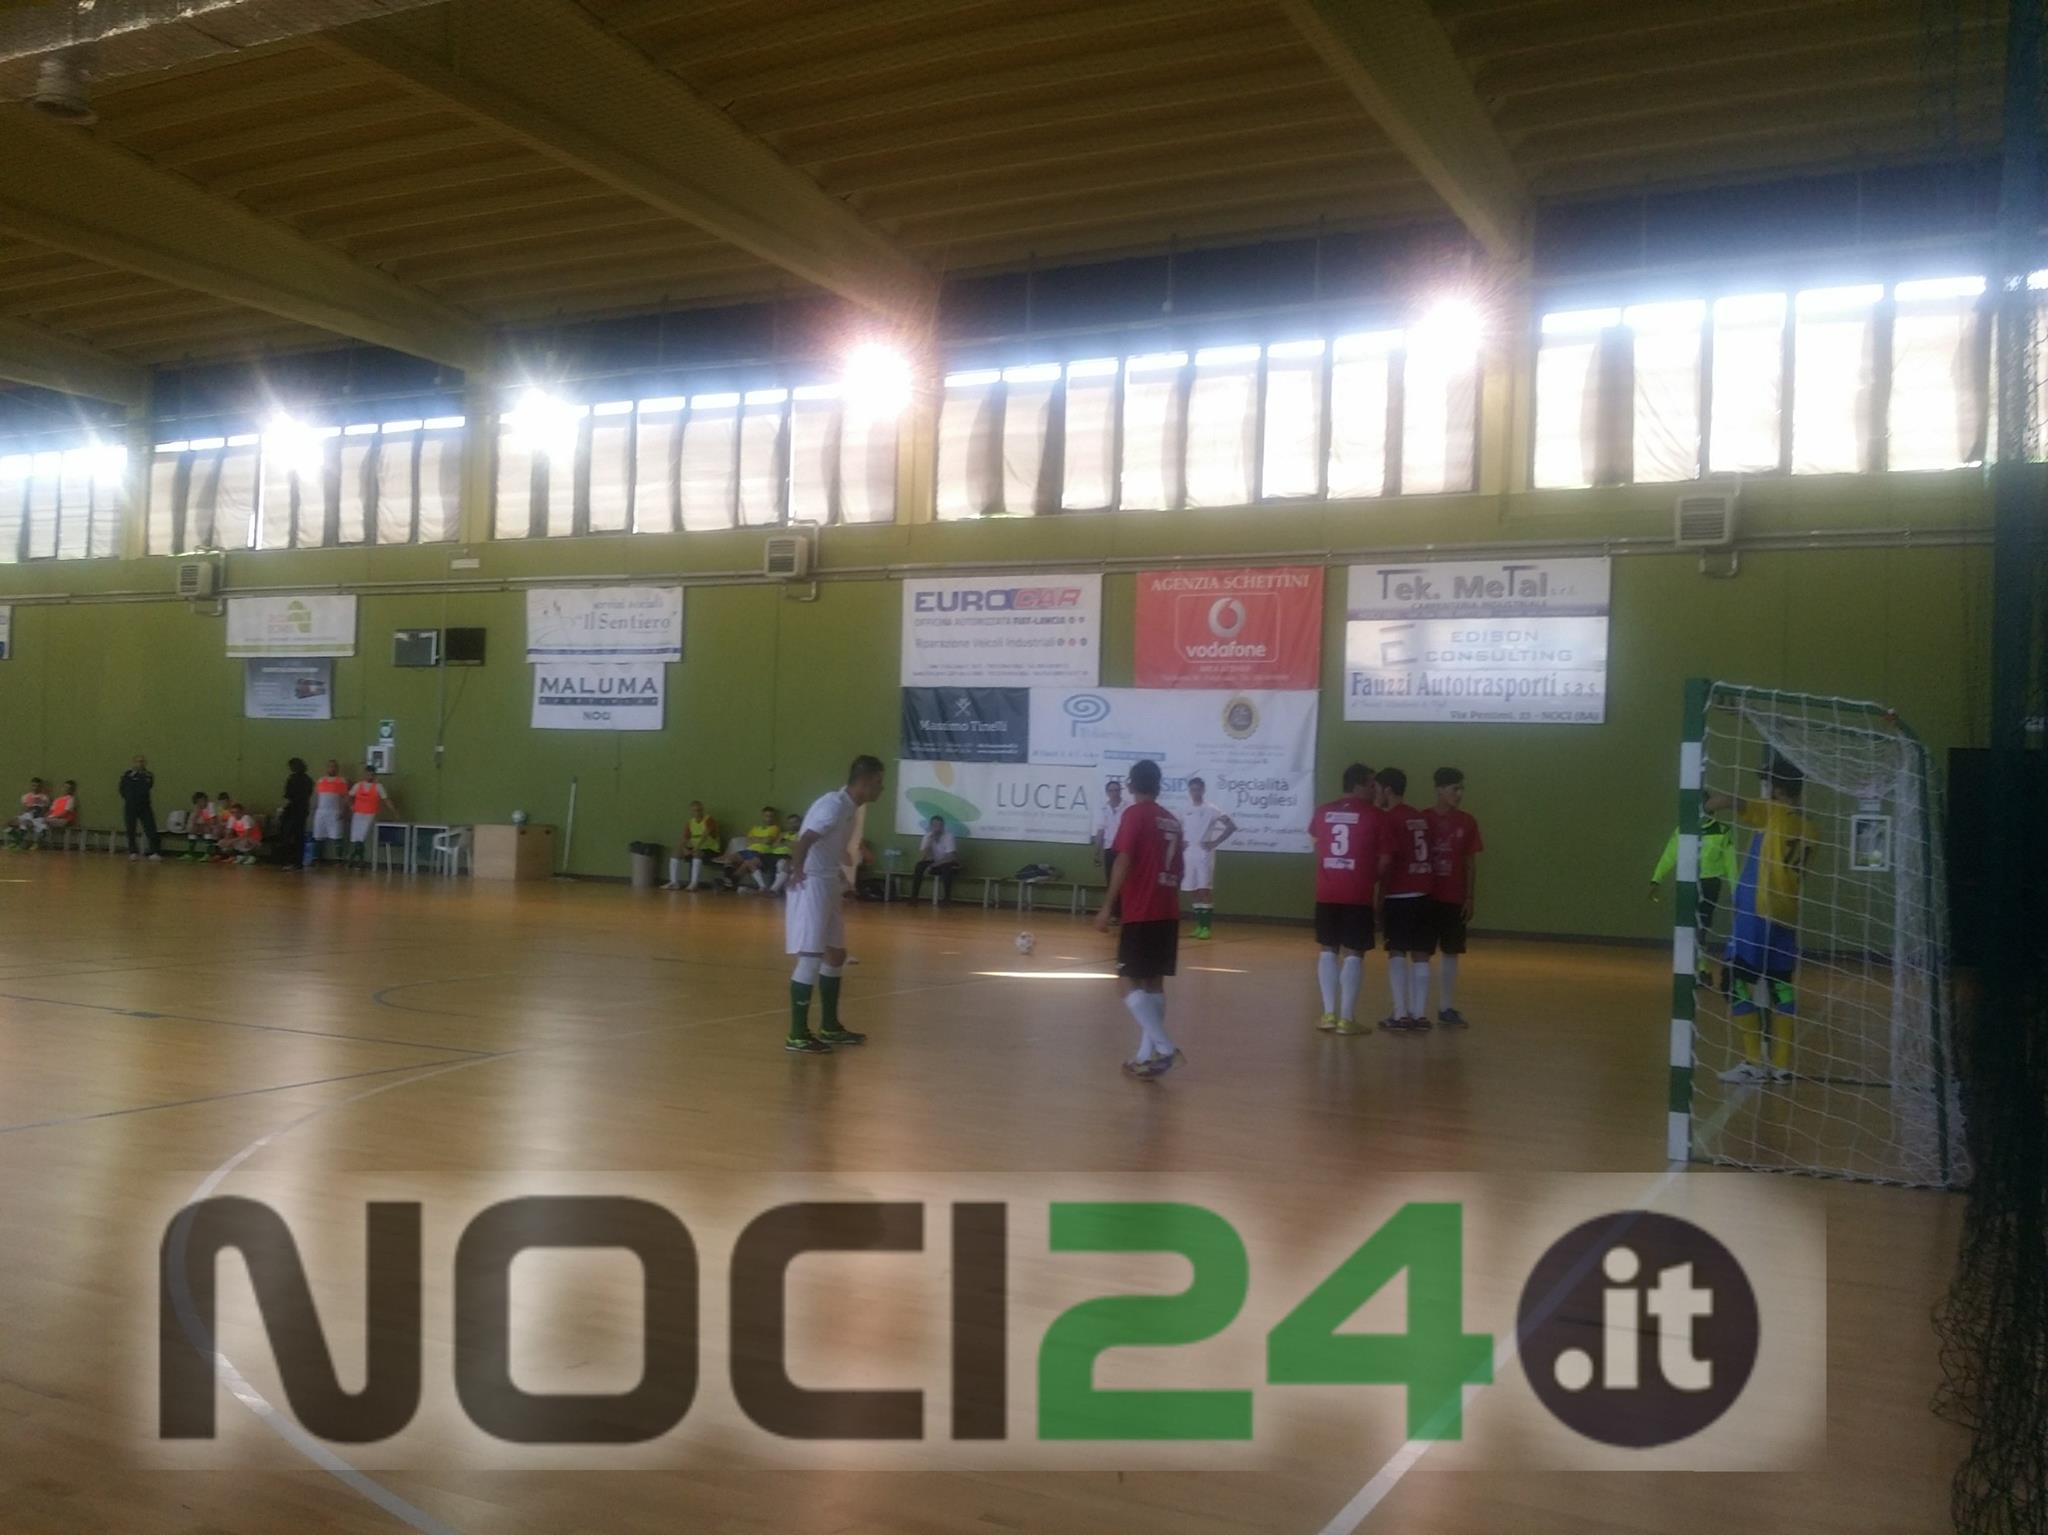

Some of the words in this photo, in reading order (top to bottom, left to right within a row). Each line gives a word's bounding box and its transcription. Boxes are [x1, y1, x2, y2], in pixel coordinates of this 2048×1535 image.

[1151, 576, 1217, 592] AGENZIA
[1224, 574, 1310, 590] SCHETTINI
[599, 612, 671, 631] Sentiero
[1450, 629, 1538, 643] EDISON
[1185, 640, 1266, 658] vodafone
[1424, 649, 1573, 663] CONSULTING
[538, 677, 658, 695] MALUMA
[1416, 671, 1557, 701] Autotrasporti
[919, 719, 969, 731] Massimo
[1216, 773, 1289, 792] Specialità
[996, 782, 1089, 812] LUCEA
[1236, 789, 1298, 810] Pugliesi
[1330, 824, 1349, 856] 3
